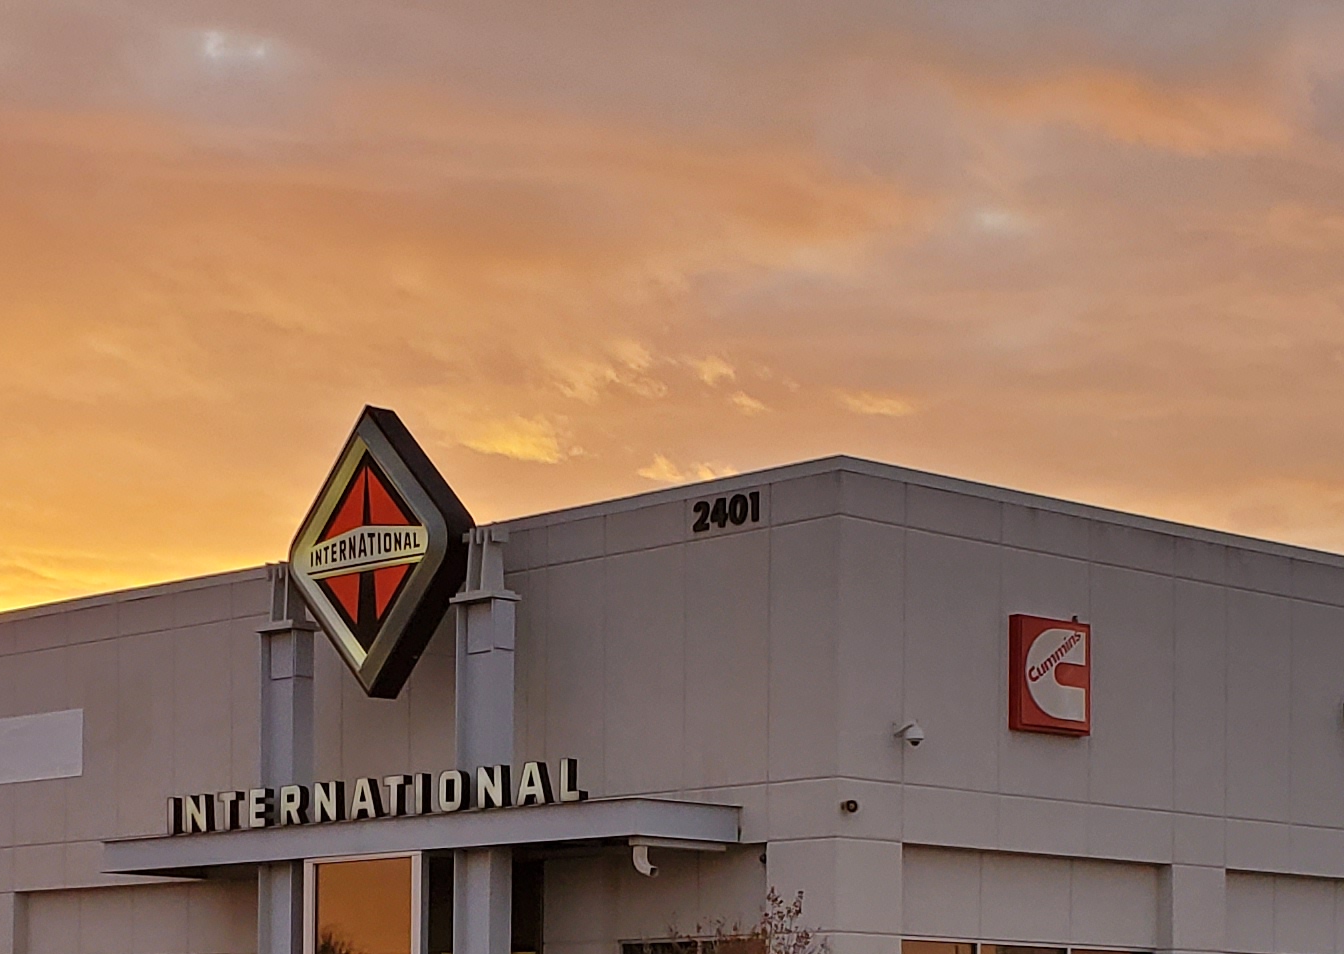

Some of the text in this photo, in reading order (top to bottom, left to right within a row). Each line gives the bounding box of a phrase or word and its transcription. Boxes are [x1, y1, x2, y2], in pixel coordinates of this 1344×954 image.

[693, 491, 760, 532] 2401
[310, 532, 421, 567] INTERNATIONAL
[1028, 632, 1081, 682] Cummins
[167, 757, 589, 837] INTERNATIONAL
